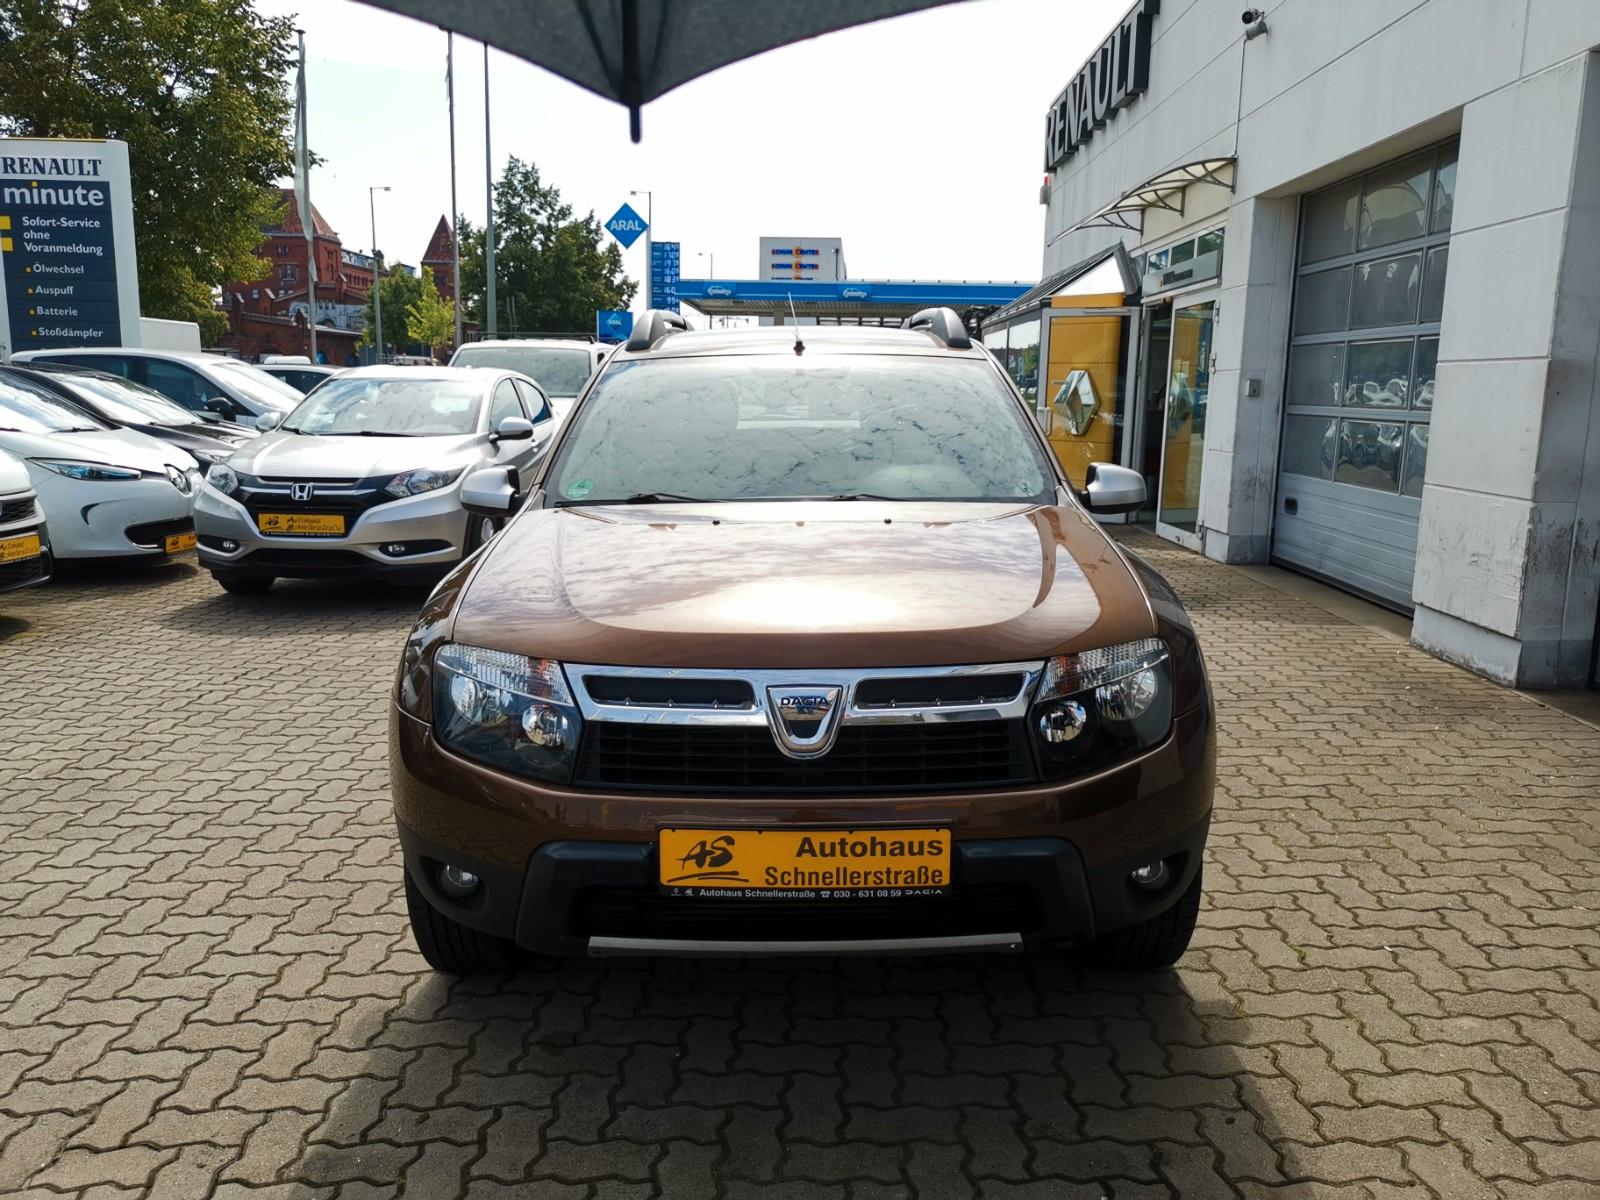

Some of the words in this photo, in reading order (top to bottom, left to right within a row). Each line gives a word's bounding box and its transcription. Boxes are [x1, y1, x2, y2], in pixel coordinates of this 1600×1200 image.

[1044, 0, 1160, 173] RENAULT
[1, 156, 102, 176] RENAULT
[4, 181, 104, 206] minute
[22, 216, 101, 228] Sofort-Service
[610, 219, 642, 231] ARAL
[23, 230, 51, 240] ohne
[24, 242, 104, 256] Voranmeldung
[33, 261, 85, 274] Ölwechsel
[35, 285, 74, 297] Auspuff
[36, 306, 79, 316] Batterie
[38, 327, 104, 339] Stoßdämpfer
[780, 696, 830, 706] DACIA
[795, 836, 944, 858] Autohaus
[764, 866, 944, 886] Schnellerstraße
[699, 888, 742, 898] Autohaus
[745, 889, 816, 898] Schnellerstraße
[833, 889, 851, 898] 030
[858, 889, 874, 898] 631
[876, 889, 888, 898] 08
[890, 889, 902, 898] 59
